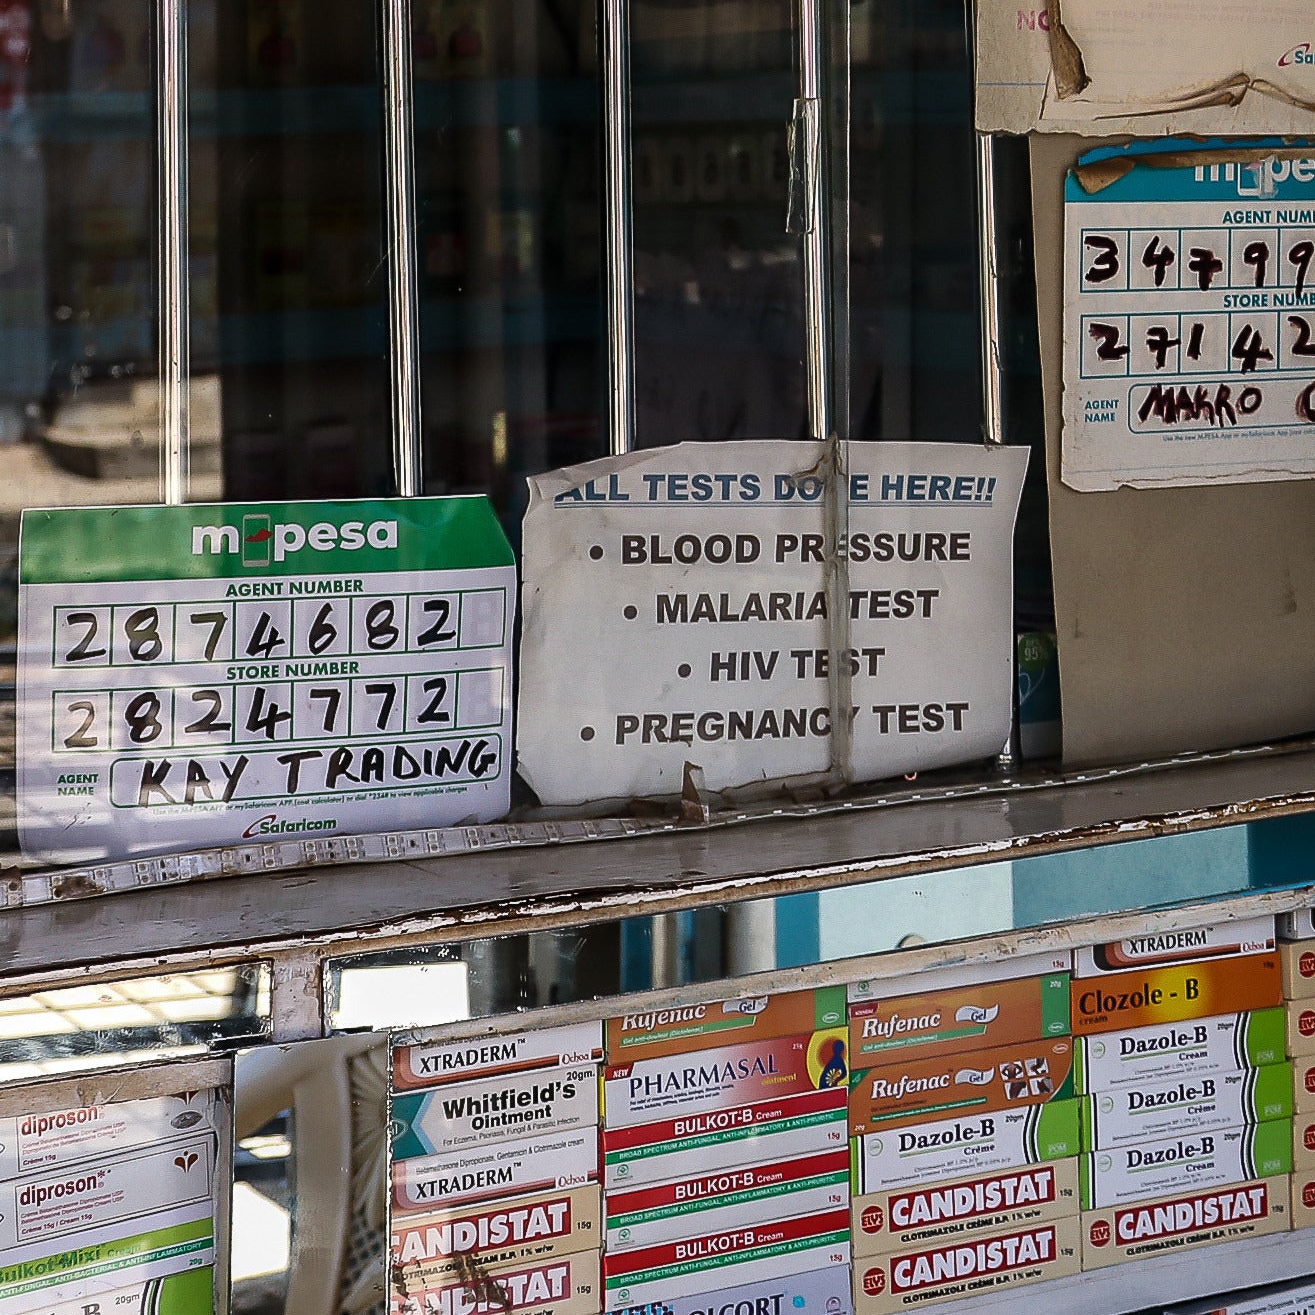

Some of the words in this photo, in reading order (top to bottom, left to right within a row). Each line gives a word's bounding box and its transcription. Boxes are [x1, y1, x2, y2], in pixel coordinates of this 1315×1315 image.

[1223, 210, 1272, 224] AGENT
[1223, 294, 1270, 308] STORE
[642, 474, 761, 501] TESTS
[775, 474, 868, 501] DOE
[881, 474, 997, 501] HERE!!
[621, 534, 761, 565] BLOOD
[775, 532, 971, 563] PRSSURE
[225, 582, 287, 597] AGENT
[291, 579, 363, 595] NUMBER
[656, 590, 829, 623] MALARIA
[849, 589, 939, 620] TEST
[226, 664, 282, 680] STORE
[286, 661, 360, 677] NUMBER
[711, 651, 779, 682] HIV
[791, 648, 885, 679] TEST
[873, 703, 969, 733] TEST
[138, 754, 248, 807] KAY
[278, 739, 498, 794] TRADING
[259, 817, 337, 835] Safaricom
[1078, 986, 1162, 1014] Clozole
[862, 1011, 941, 1039] Rufenac
[970, 1008, 987, 1022] Gel
[1119, 1025, 1208, 1055] Dazole-B
[420, 1042, 517, 1074] XTRADERM
[629, 1053, 780, 1099] PHARMASAL
[472, 1105, 552, 1131] Ointment
[674, 1106, 753, 1135] BULKOT-B
[755, 1107, 782, 1120] Cream
[19, 1175, 97, 1206] diproson
[892, 1172, 1052, 1223] CANDISTAT
